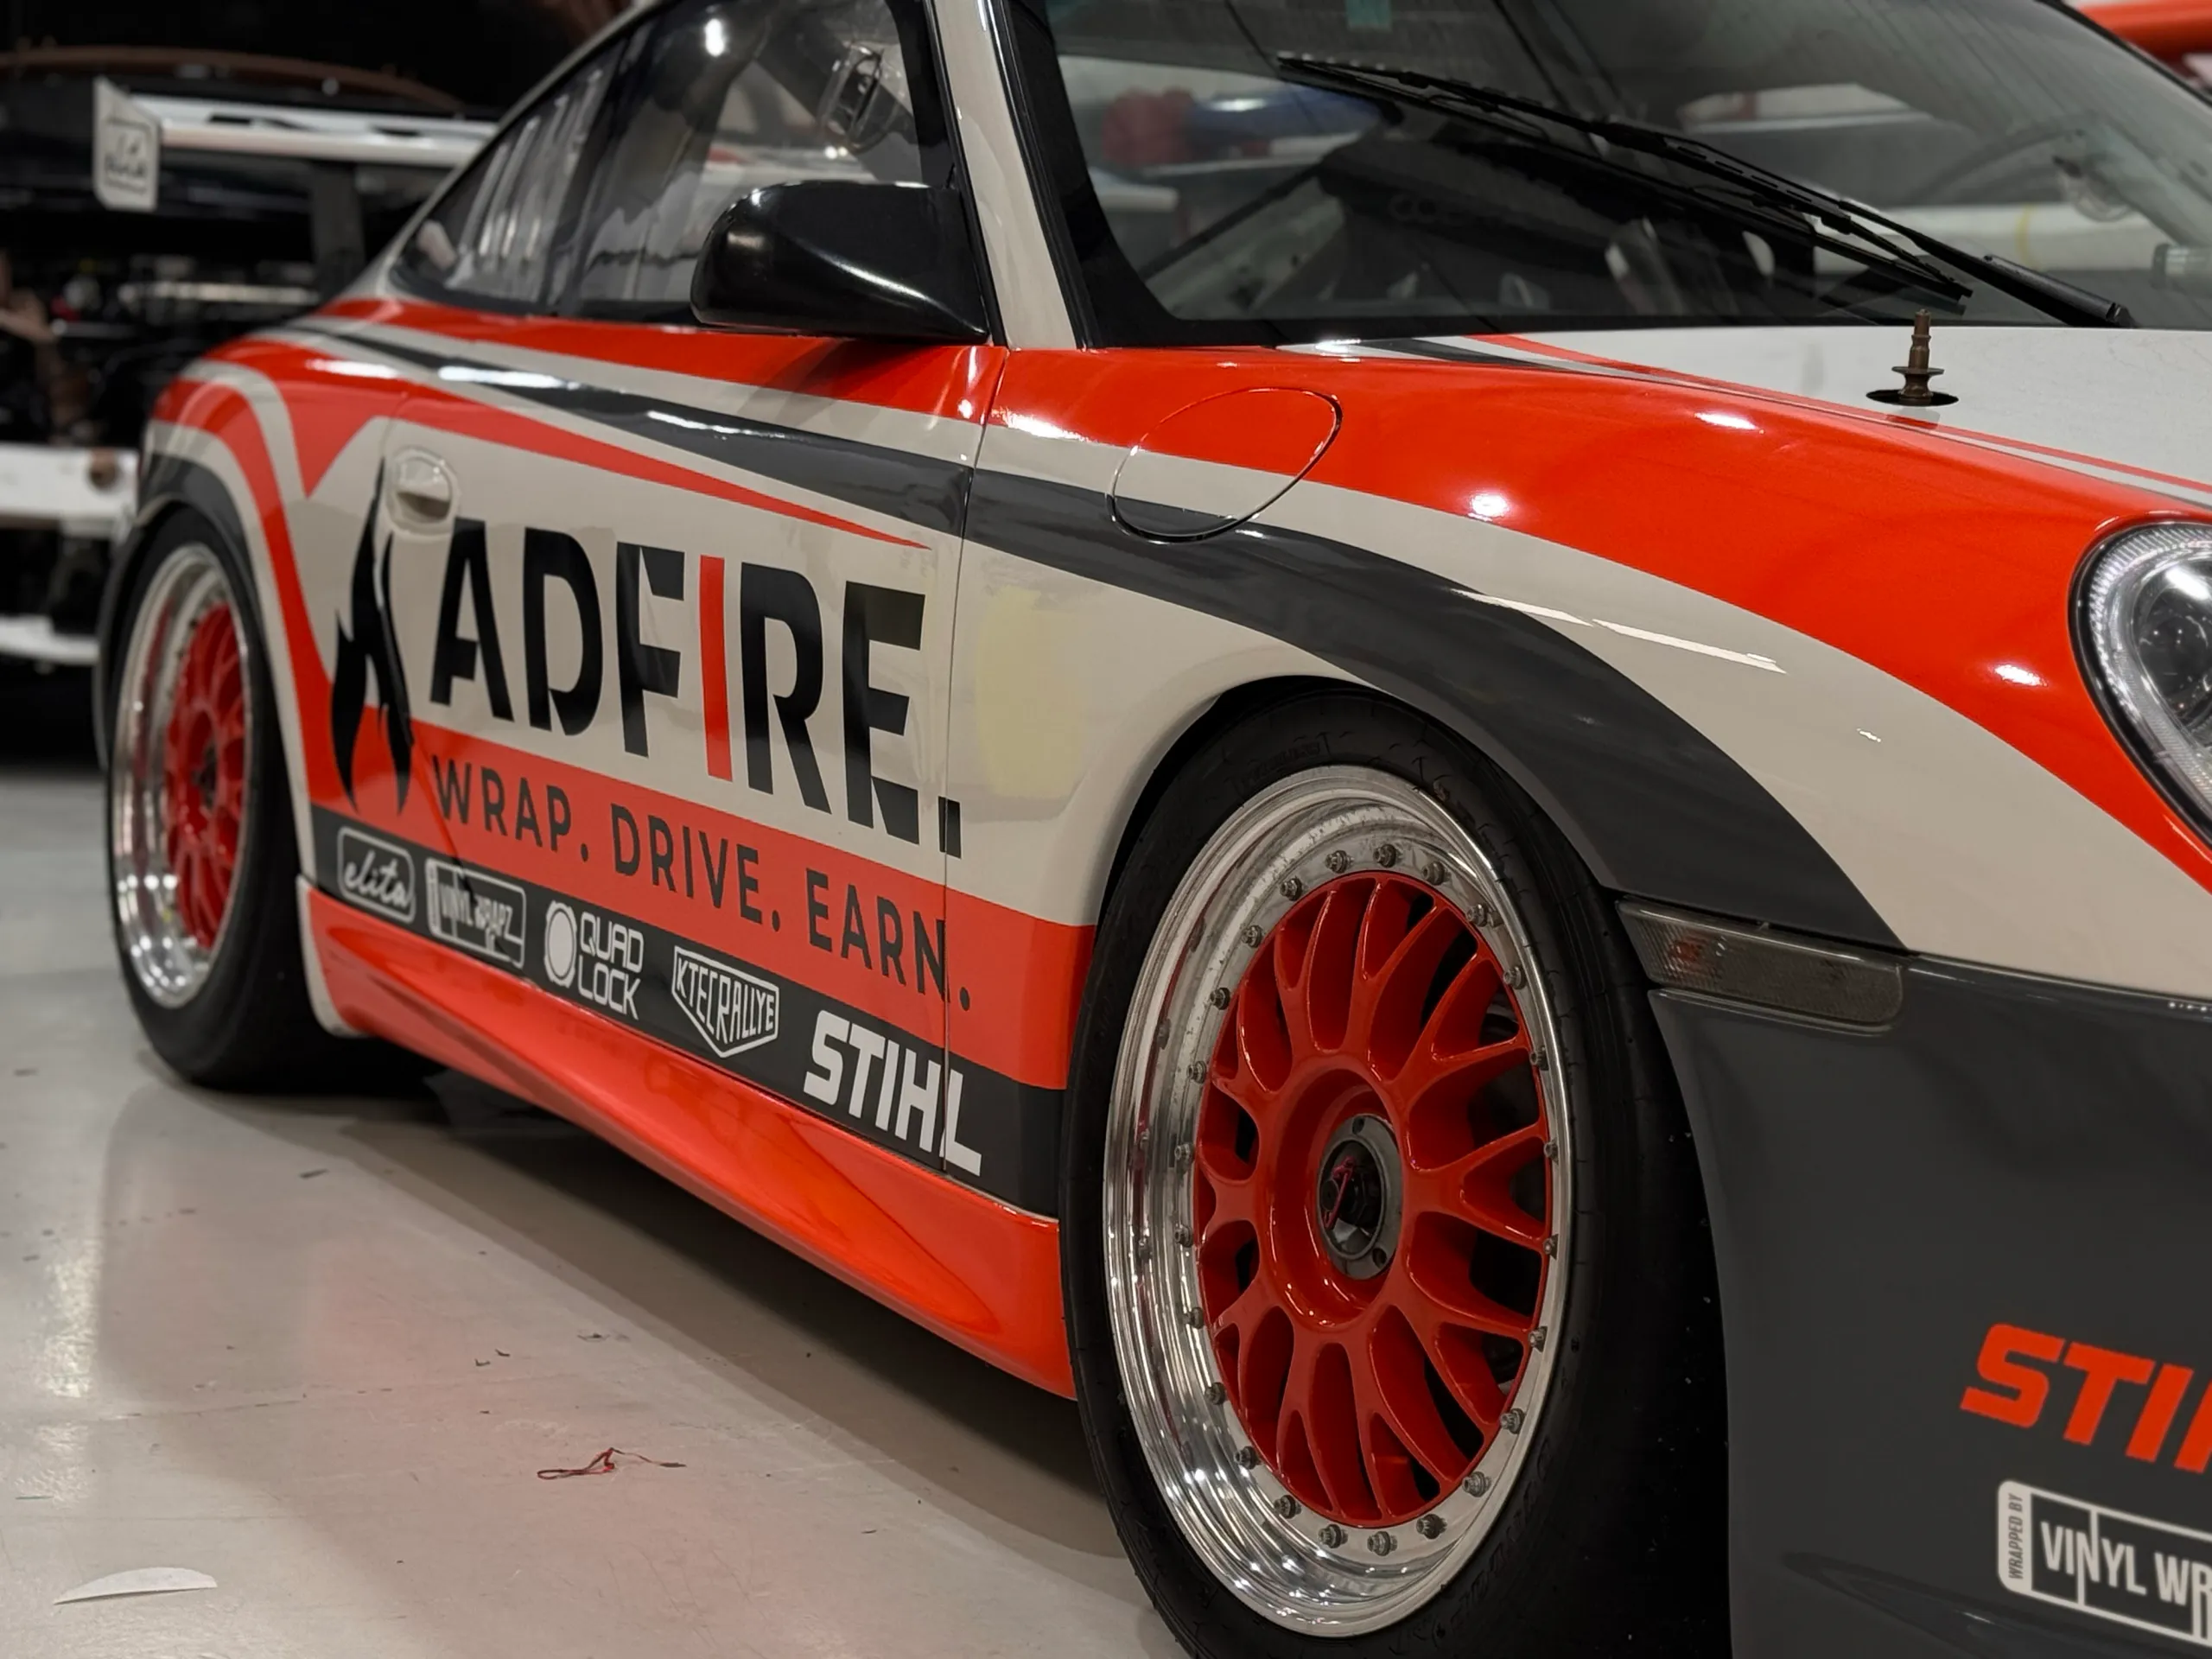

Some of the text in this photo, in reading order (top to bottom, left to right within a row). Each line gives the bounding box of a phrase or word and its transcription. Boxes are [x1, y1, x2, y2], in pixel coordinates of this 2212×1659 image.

[429, 517, 962, 859] ADFIRE.
[432, 754, 970, 1011] WRAP. DRIVE. EARN.
[579, 912, 644, 974] QUAD
[577, 964, 640, 1020] LOCK
[803, 1009, 982, 1177] STIHL
[2007, 1493, 2024, 1580] WRAPPED BY
[2040, 1516, 2146, 1600] VINYL
